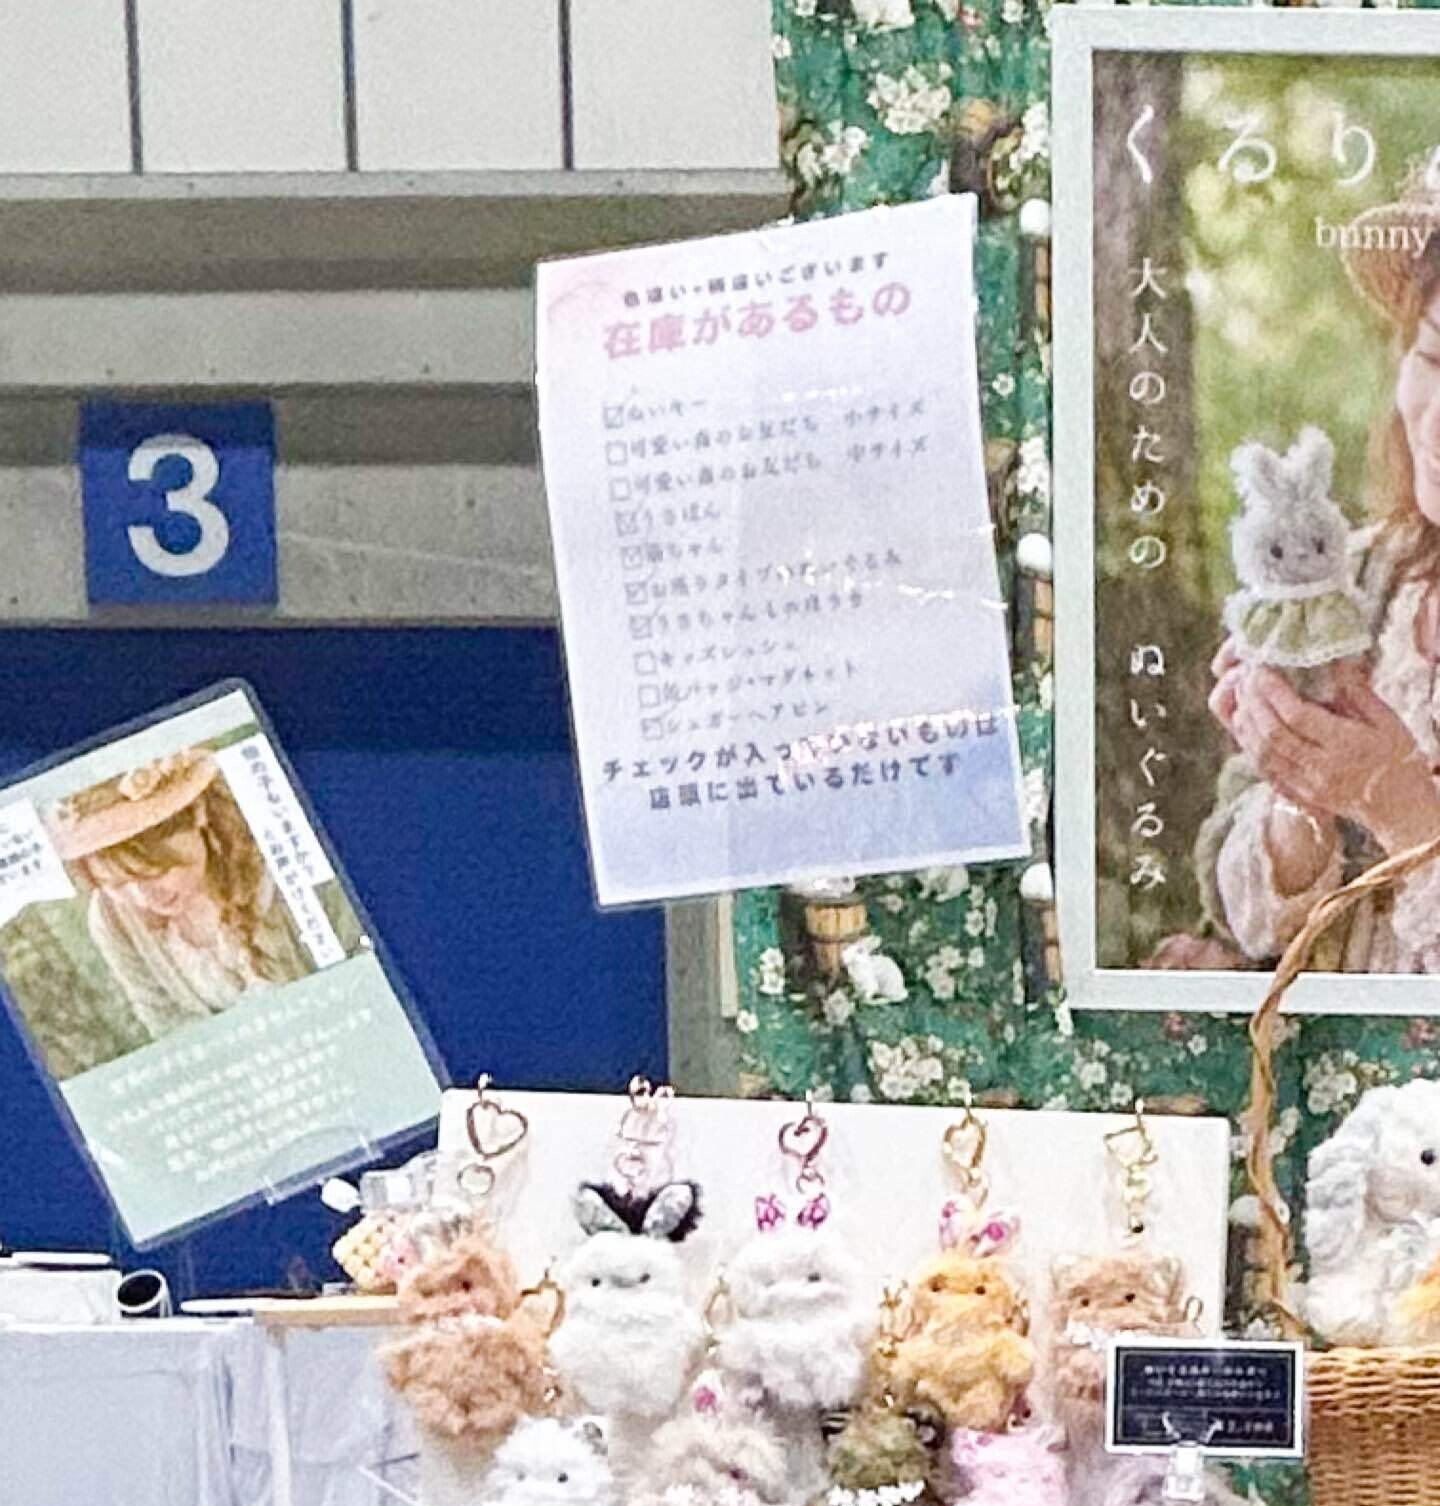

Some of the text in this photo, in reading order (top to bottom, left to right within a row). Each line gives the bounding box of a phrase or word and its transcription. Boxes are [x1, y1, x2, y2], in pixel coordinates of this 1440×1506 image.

[1314, 217, 1434, 260] bunny
[603, 280, 912, 360] 在庫があるもの
[124, 432, 230, 576] 3
[1127, 257, 1169, 891] 大人のための ぬいぐるみ
[649, 752, 962, 811] 店頭に出ているだけです
